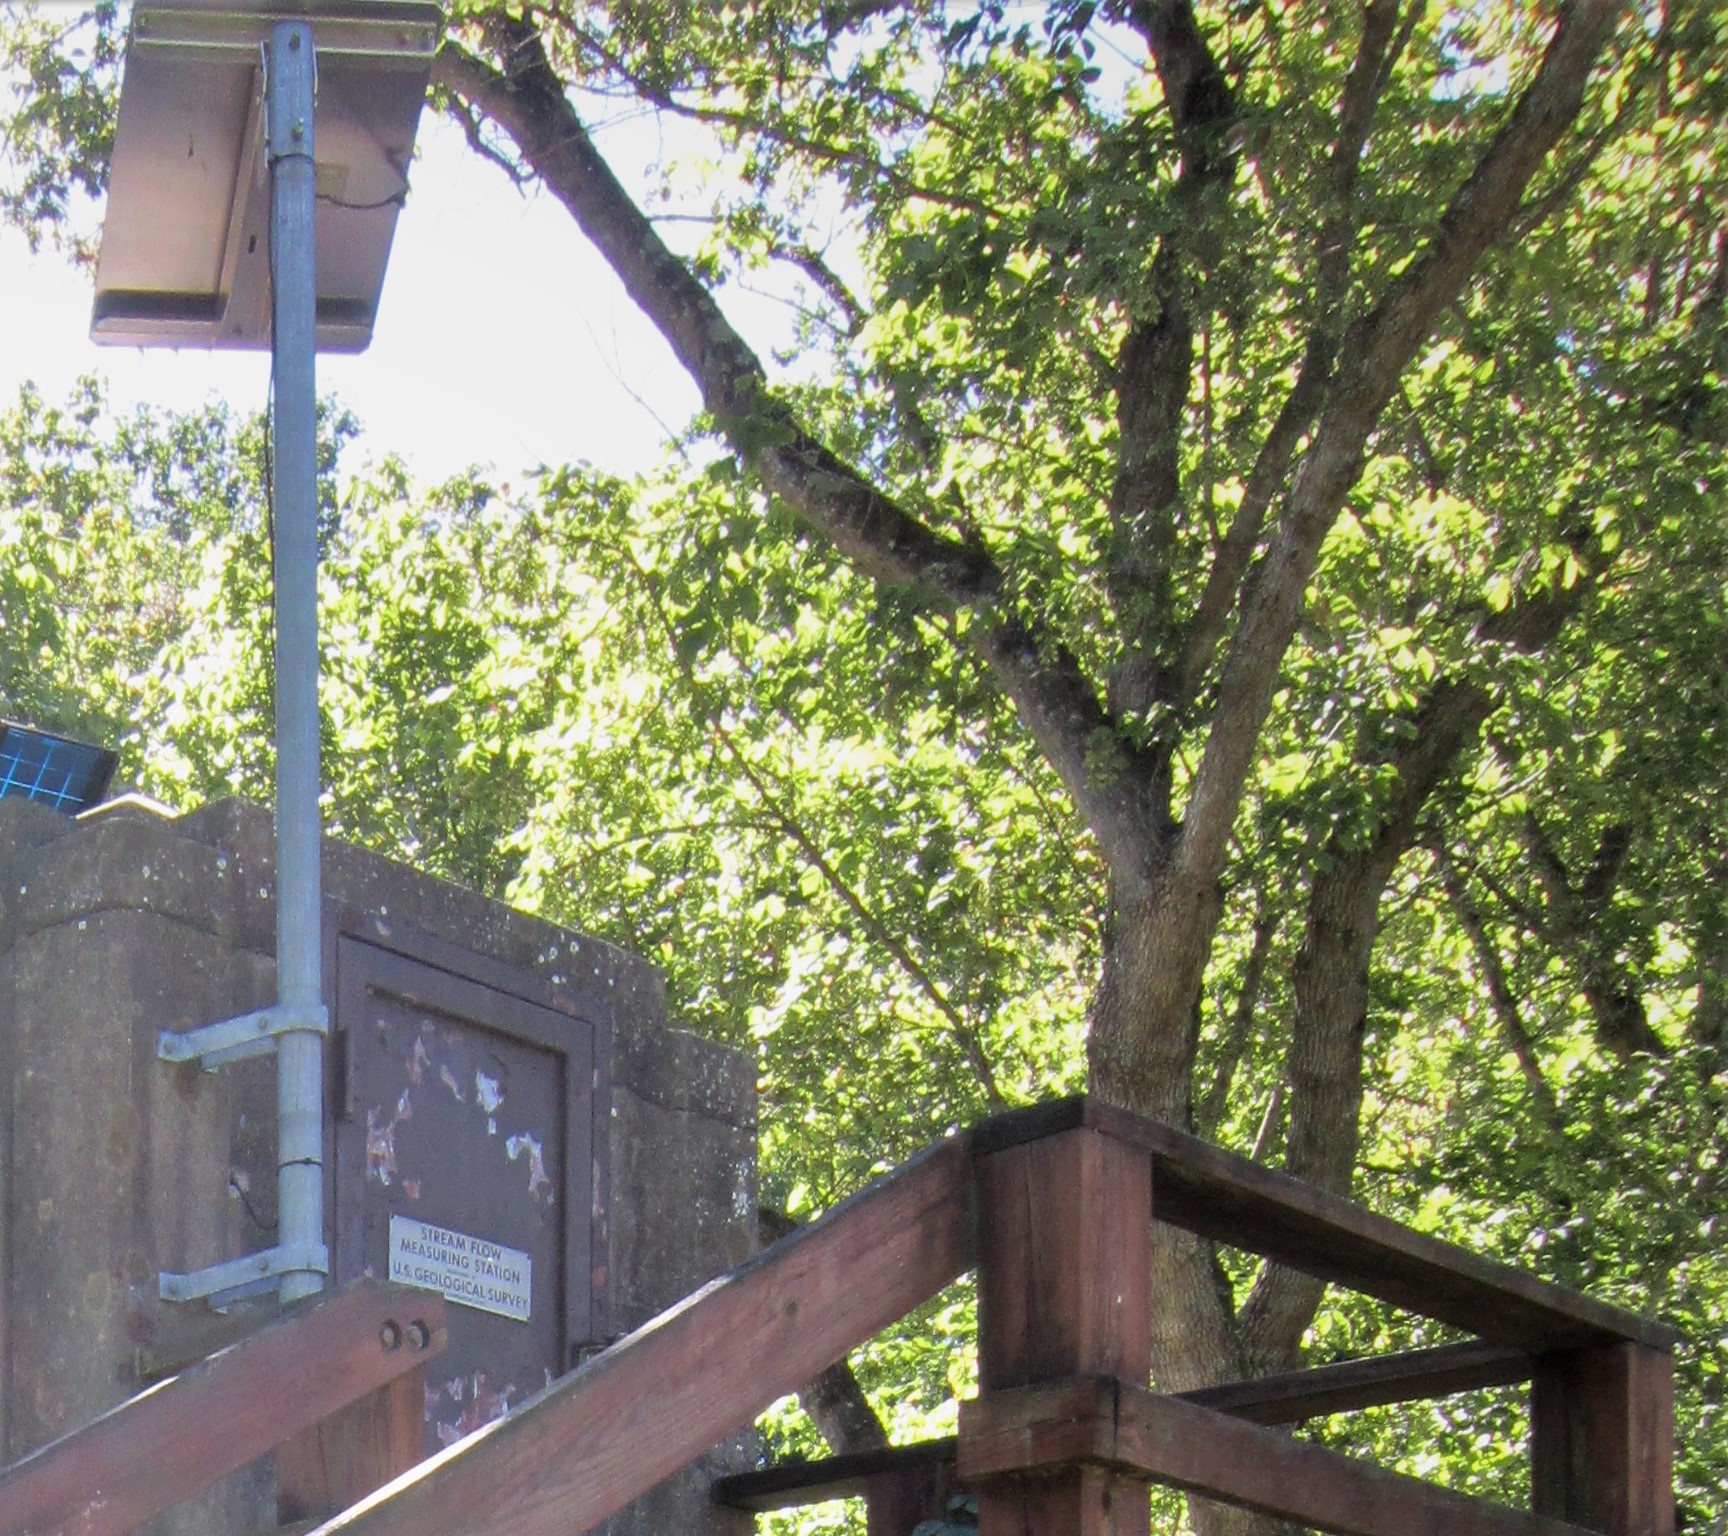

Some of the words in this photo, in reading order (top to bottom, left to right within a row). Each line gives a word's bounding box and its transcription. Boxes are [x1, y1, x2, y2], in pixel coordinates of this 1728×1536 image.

[400, 1238, 469, 1269] MEASURING
[474, 1259, 521, 1285] STATION
[422, 1227, 466, 1250] STREAM
[471, 1242, 502, 1261] FLOW
[393, 1261, 412, 1278] U.S.
[414, 1267, 485, 1299] GEOLOGICAL
[488, 1289, 529, 1309] SURVEY
